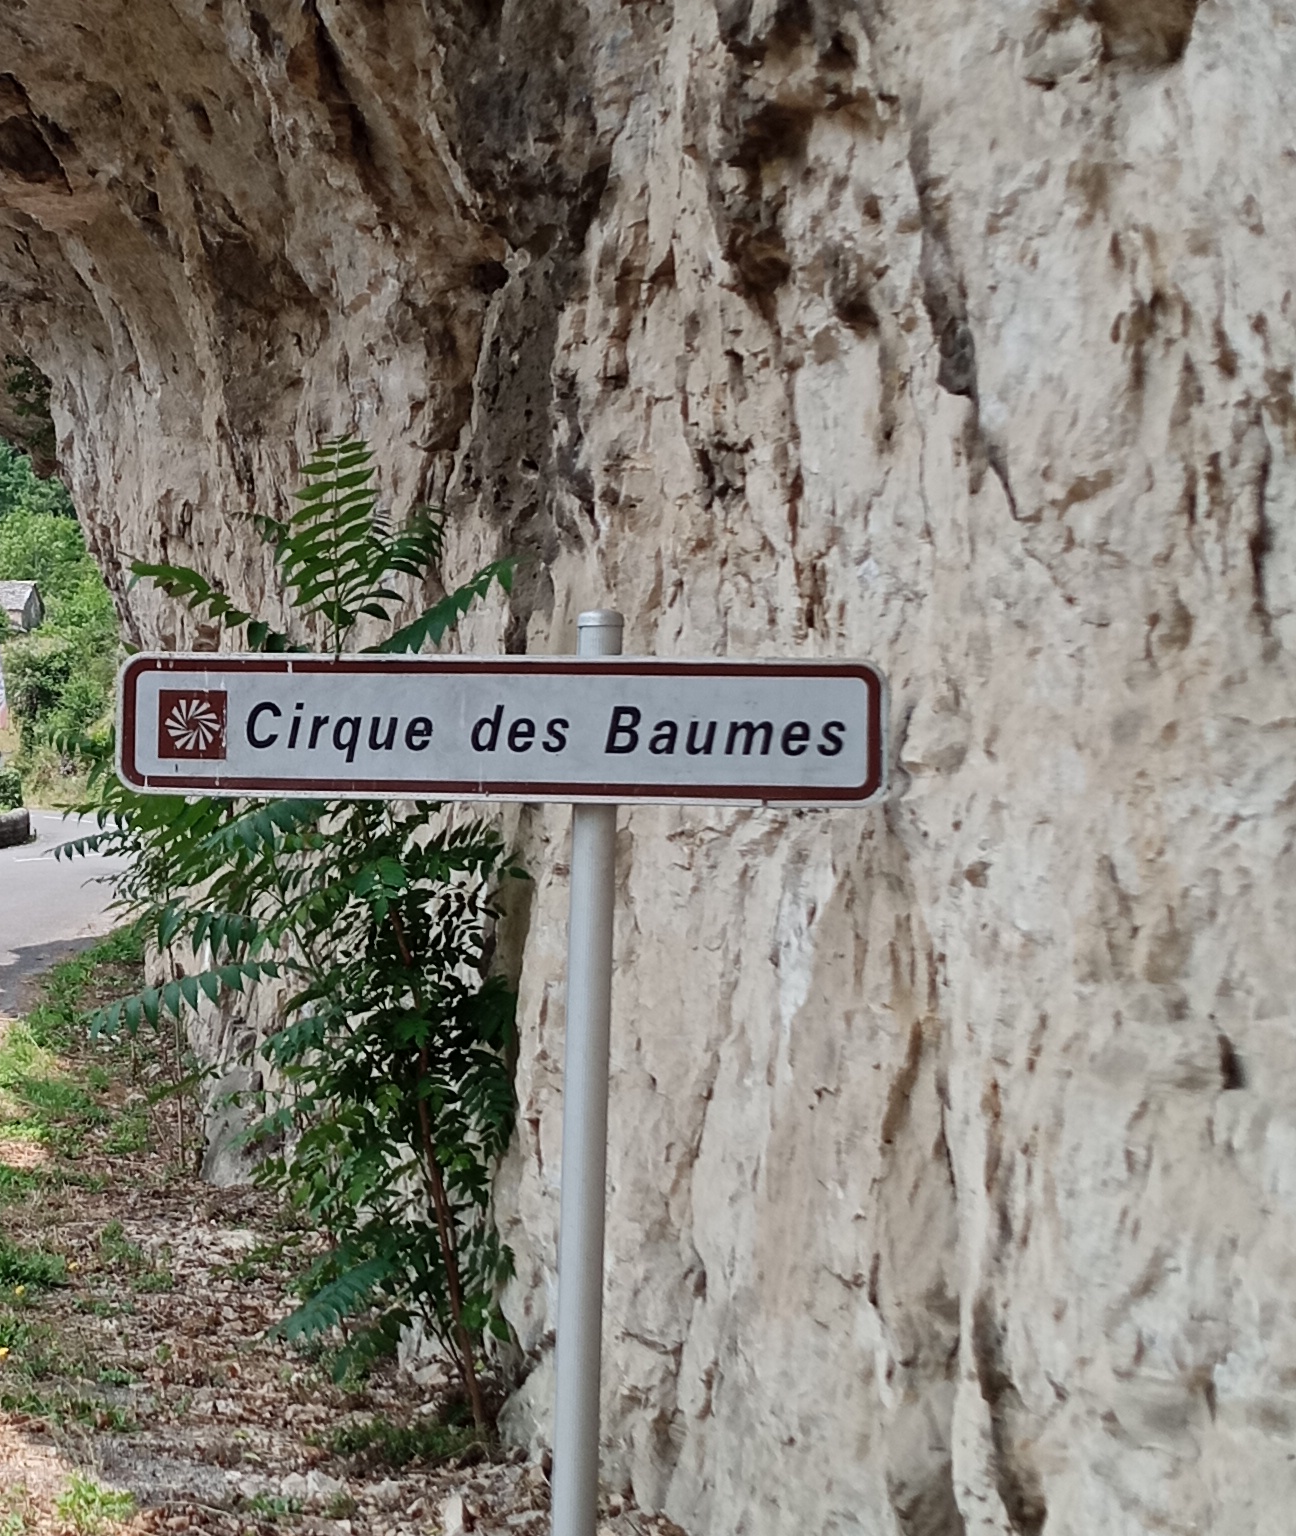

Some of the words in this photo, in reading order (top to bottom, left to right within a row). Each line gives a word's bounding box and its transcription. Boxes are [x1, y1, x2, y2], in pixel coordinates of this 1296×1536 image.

[245, 701, 434, 763] Cirque
[471, 704, 570, 753] des
[604, 706, 847, 756] Baumes
